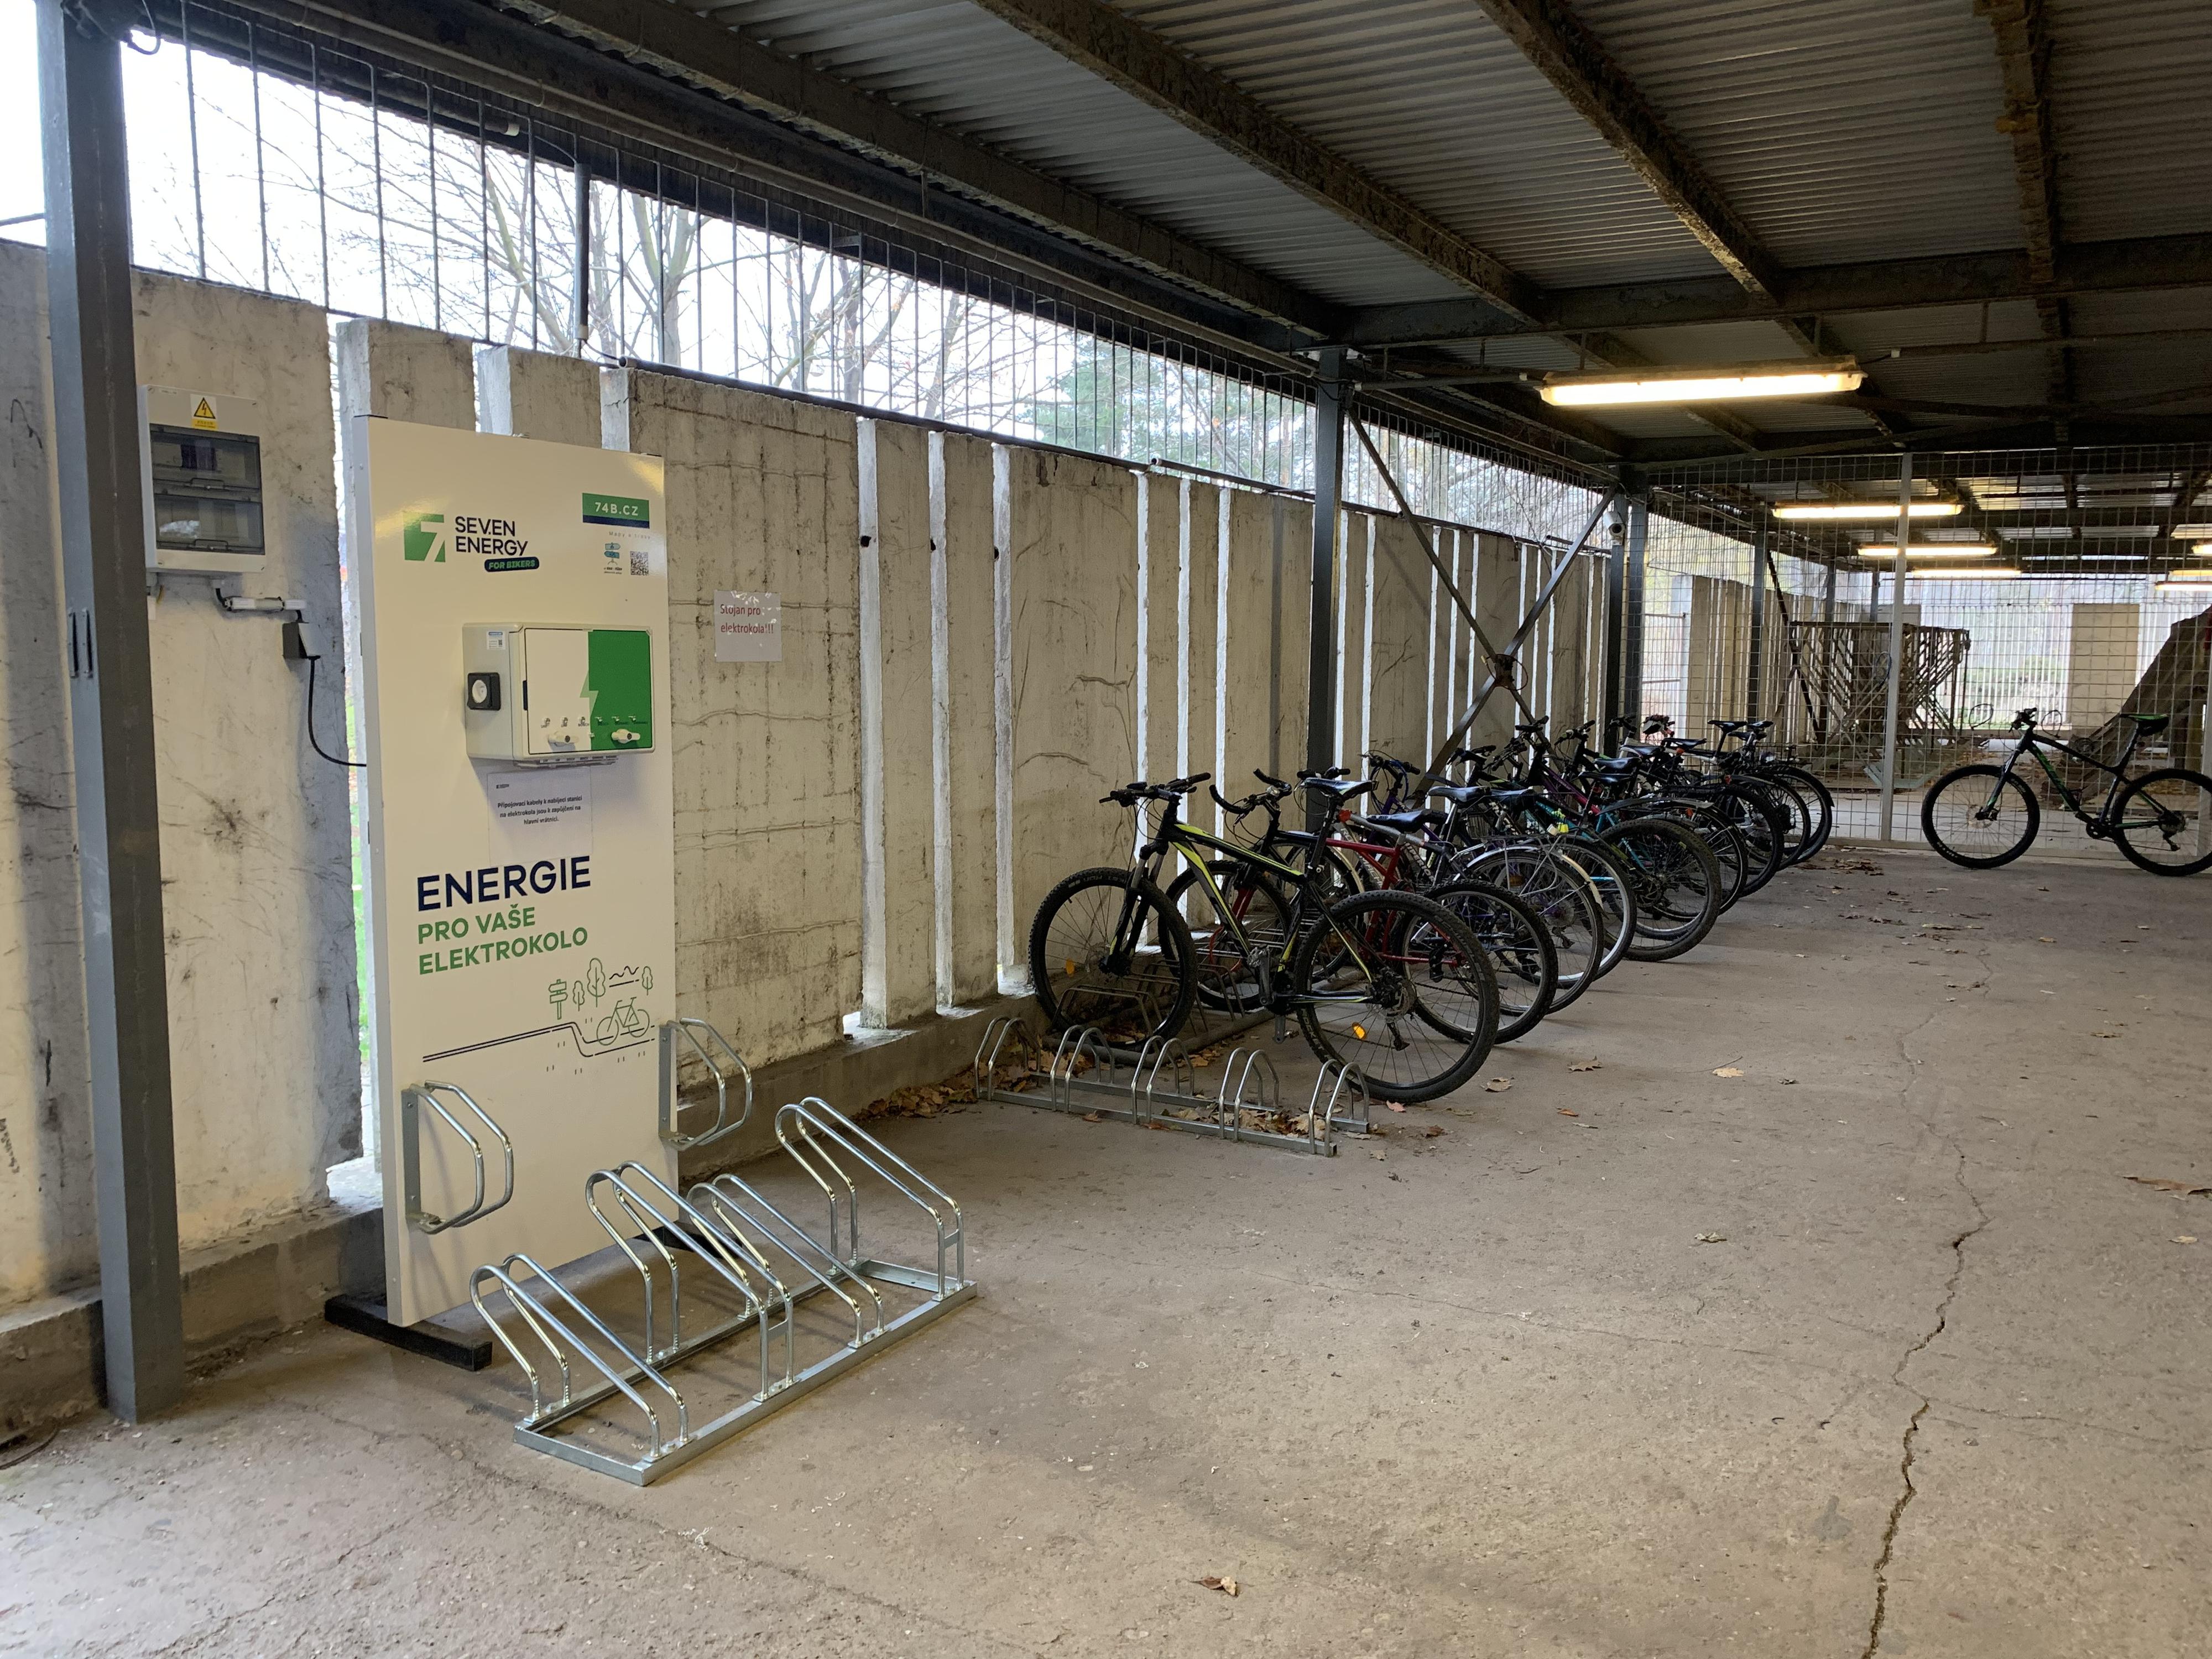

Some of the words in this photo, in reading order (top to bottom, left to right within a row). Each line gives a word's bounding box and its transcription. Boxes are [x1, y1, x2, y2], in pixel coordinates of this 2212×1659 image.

[594, 502, 638, 516] 74B.CZ
[456, 535, 528, 556] ENERGY
[489, 561, 505, 570] FOR
[507, 560, 535, 568] BIKERS
[720, 604, 745, 617] Stojan
[748, 607, 761, 617] pro
[721, 622, 774, 634] elektrokola!!!
[417, 855, 591, 911] ENERGIE
[418, 917, 469, 945] PRO
[475, 903, 535, 934] VAŠE
[419, 927, 588, 975] ELEKTROKOLO
